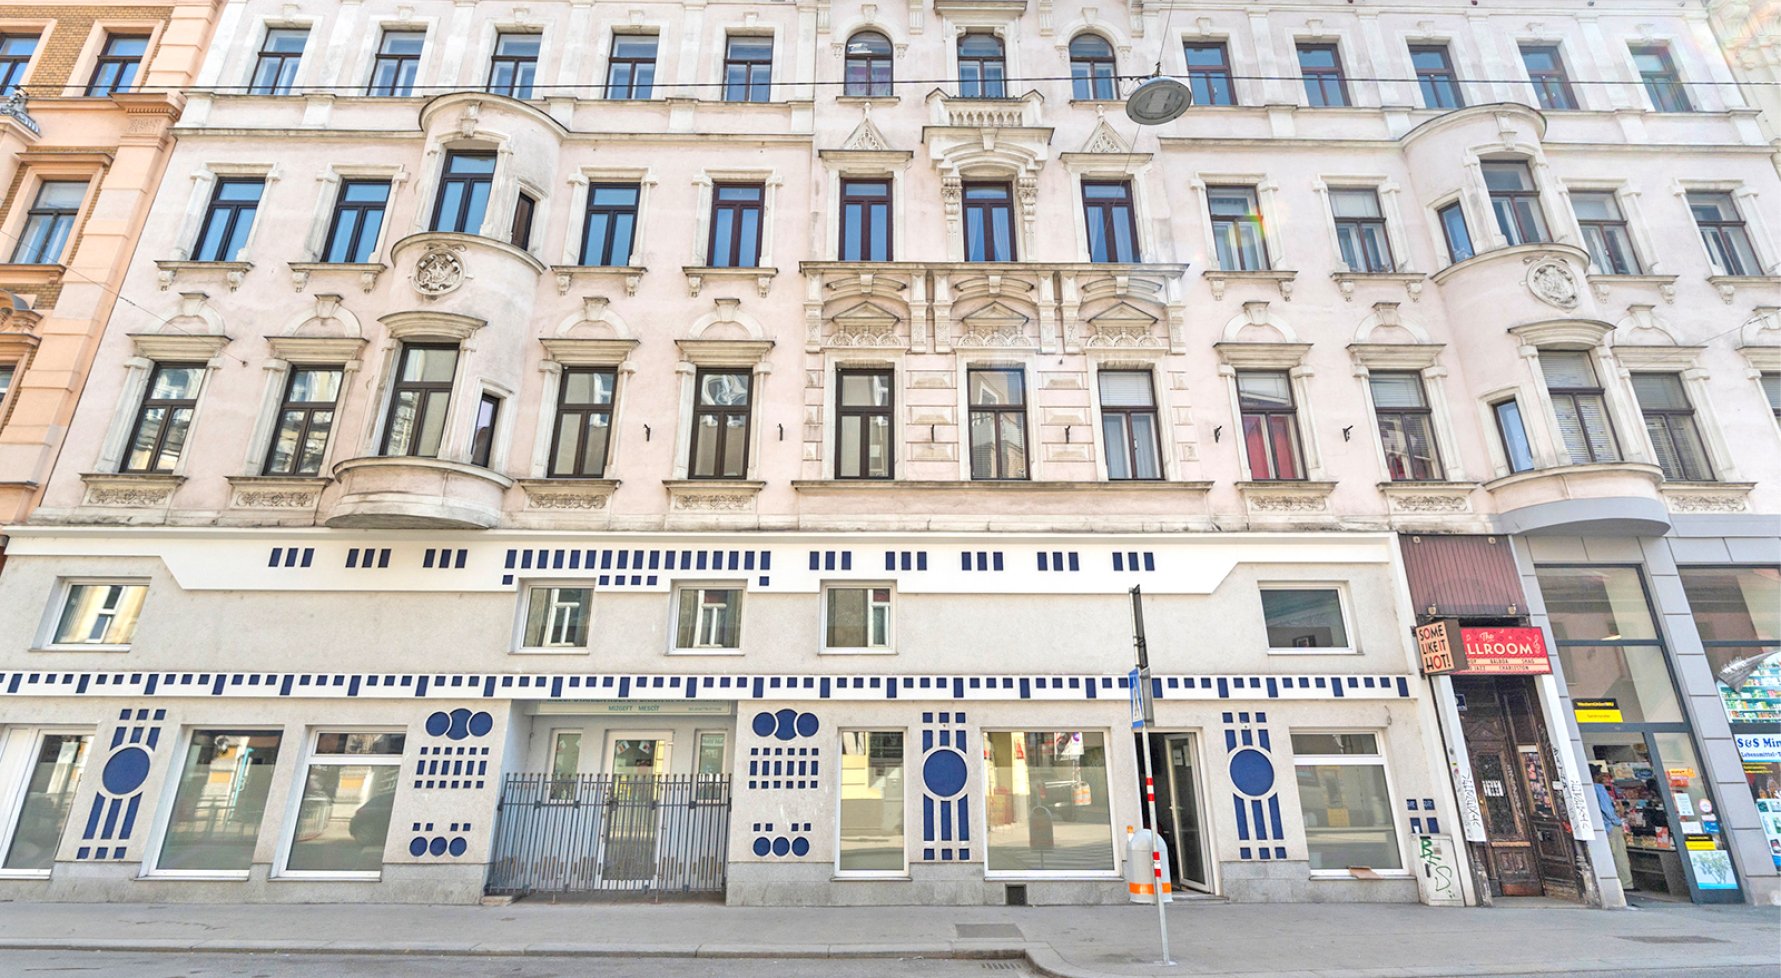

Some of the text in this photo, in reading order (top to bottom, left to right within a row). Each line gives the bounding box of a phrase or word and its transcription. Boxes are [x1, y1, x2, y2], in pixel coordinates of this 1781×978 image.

[1418, 625, 1444, 641] SOME
[1479, 631, 1495, 642] The
[1421, 639, 1447, 655] LIKE IT
[1465, 643, 1533, 655] LLROOM
[1425, 654, 1452, 671] HOT!
[1737, 737, 1760, 749] S&S
